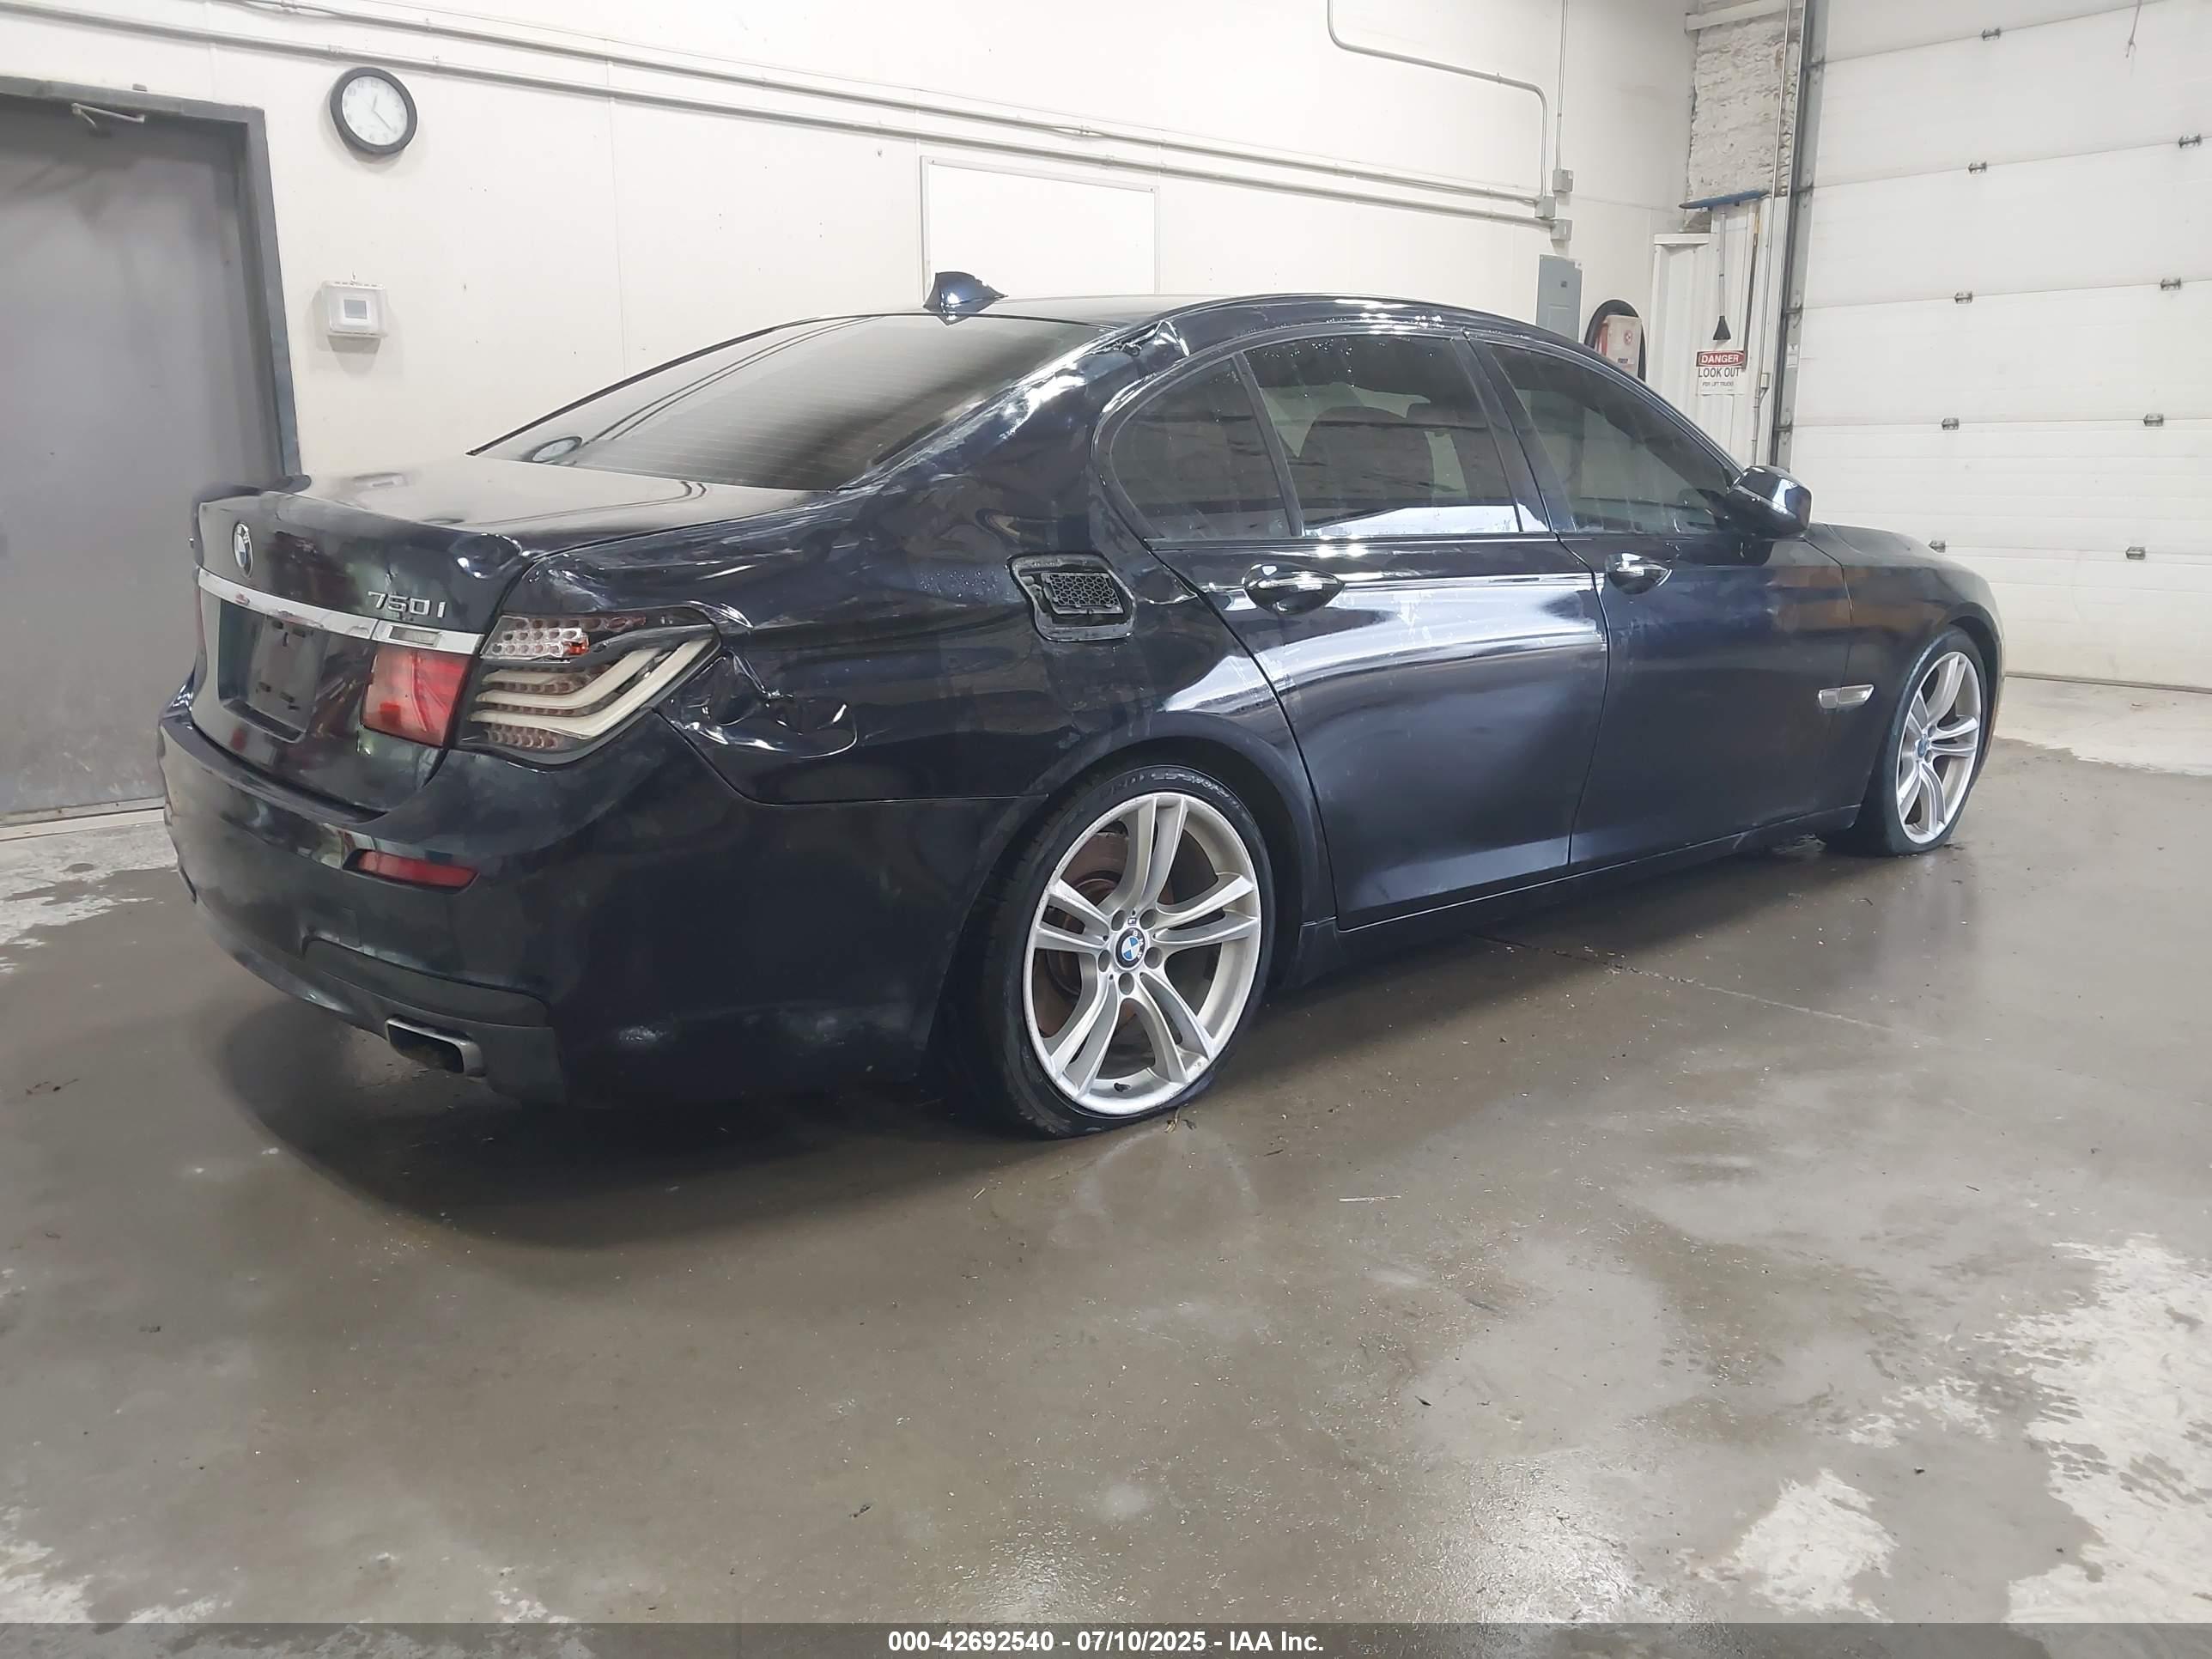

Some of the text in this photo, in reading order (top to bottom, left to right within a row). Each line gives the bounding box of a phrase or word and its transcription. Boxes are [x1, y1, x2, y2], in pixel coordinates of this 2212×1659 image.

[1701, 354, 1739, 364] DANGER
[1698, 367, 1739, 378] LOOK OUT
